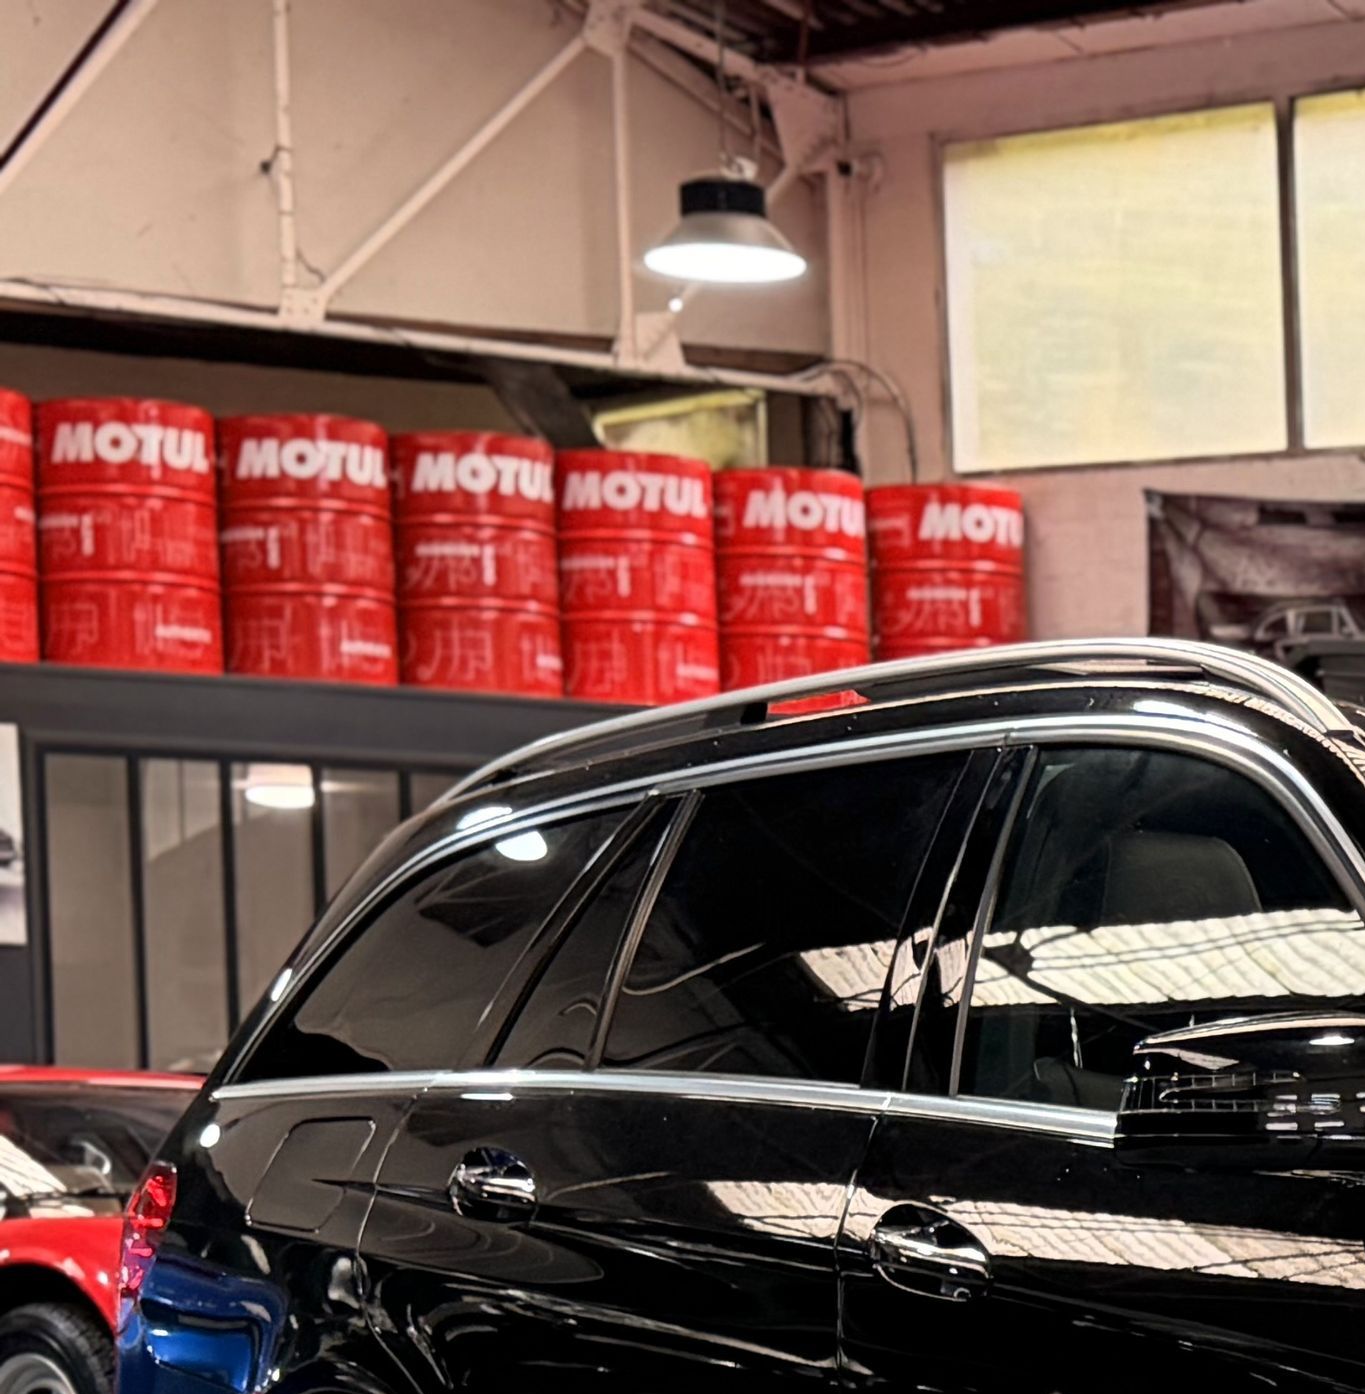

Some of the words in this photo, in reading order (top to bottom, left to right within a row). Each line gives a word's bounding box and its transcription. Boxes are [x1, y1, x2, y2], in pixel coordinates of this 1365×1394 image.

[51, 421, 209, 474] MOTUL
[236, 437, 387, 489] MOTUL
[562, 469, 708, 519] MOTUL
